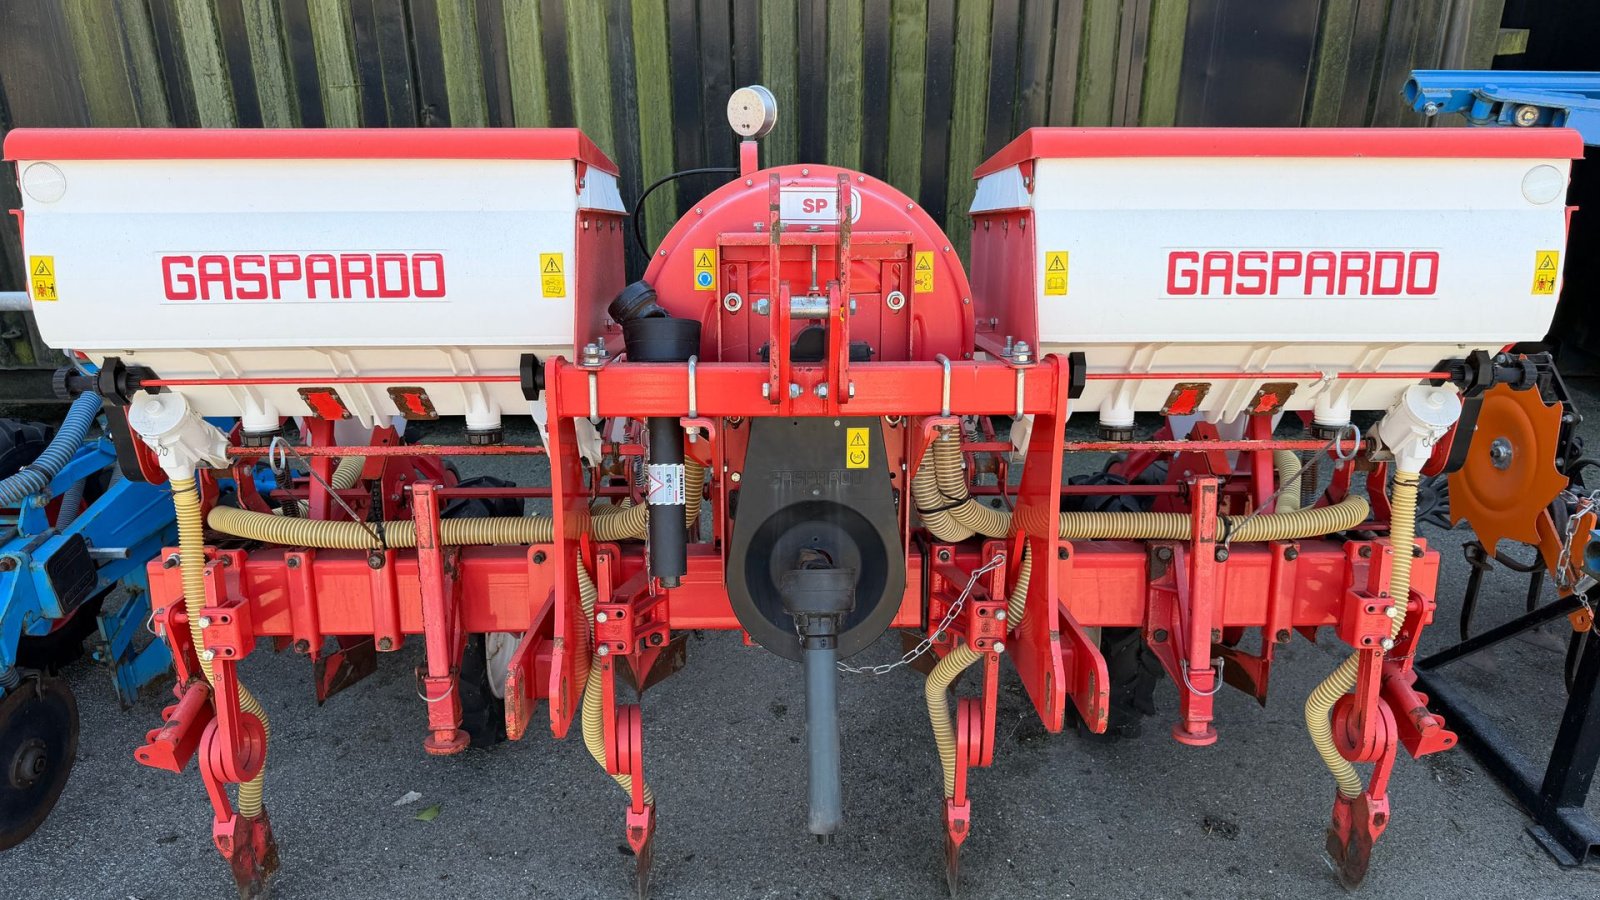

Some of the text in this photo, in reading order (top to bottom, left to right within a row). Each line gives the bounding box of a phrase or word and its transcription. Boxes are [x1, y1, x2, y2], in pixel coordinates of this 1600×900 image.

[802, 198, 828, 214] SP
[161, 253, 446, 300] GASPARDO
[1166, 251, 1440, 295] GASPARDO
